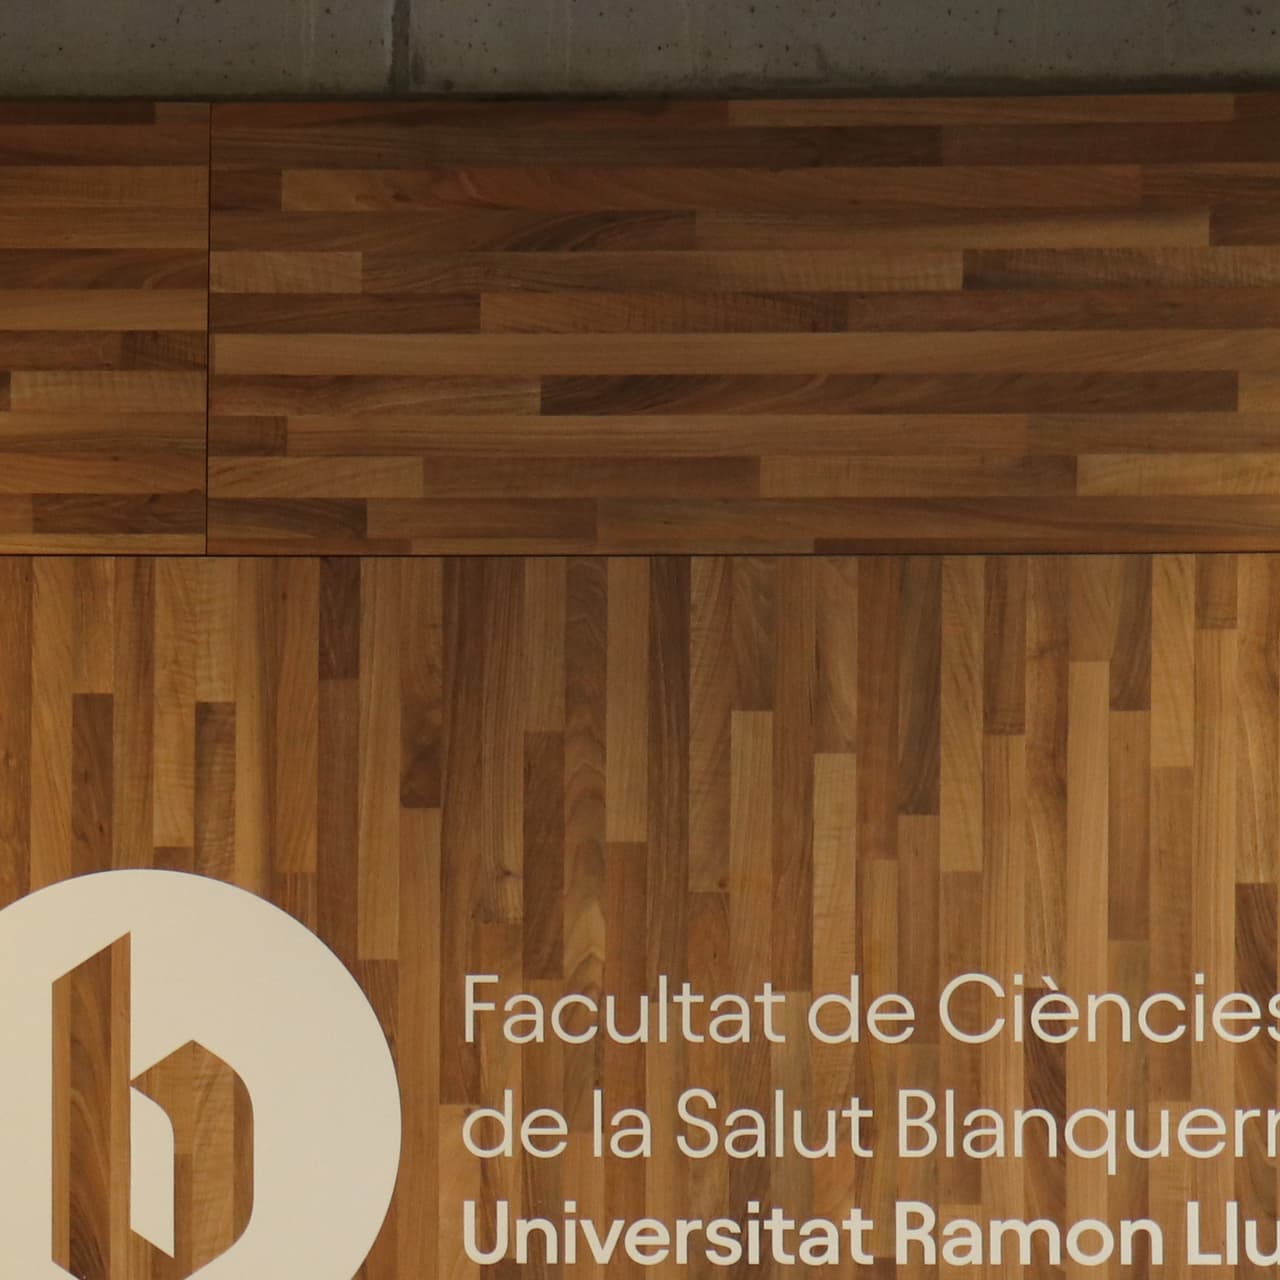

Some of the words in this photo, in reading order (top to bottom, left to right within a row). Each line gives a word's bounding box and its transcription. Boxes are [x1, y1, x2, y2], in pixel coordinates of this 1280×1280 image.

[464, 974, 786, 1044] Facultat
[808, 974, 915, 1044] de
[462, 1089, 568, 1158] de
[593, 1089, 651, 1158] la
[676, 1088, 873, 1159] Salut
[898, 1089, 1280, 1176] Blanquer
[463, 1200, 874, 1266] Universitat
[895, 1200, 1163, 1266] Ramon
